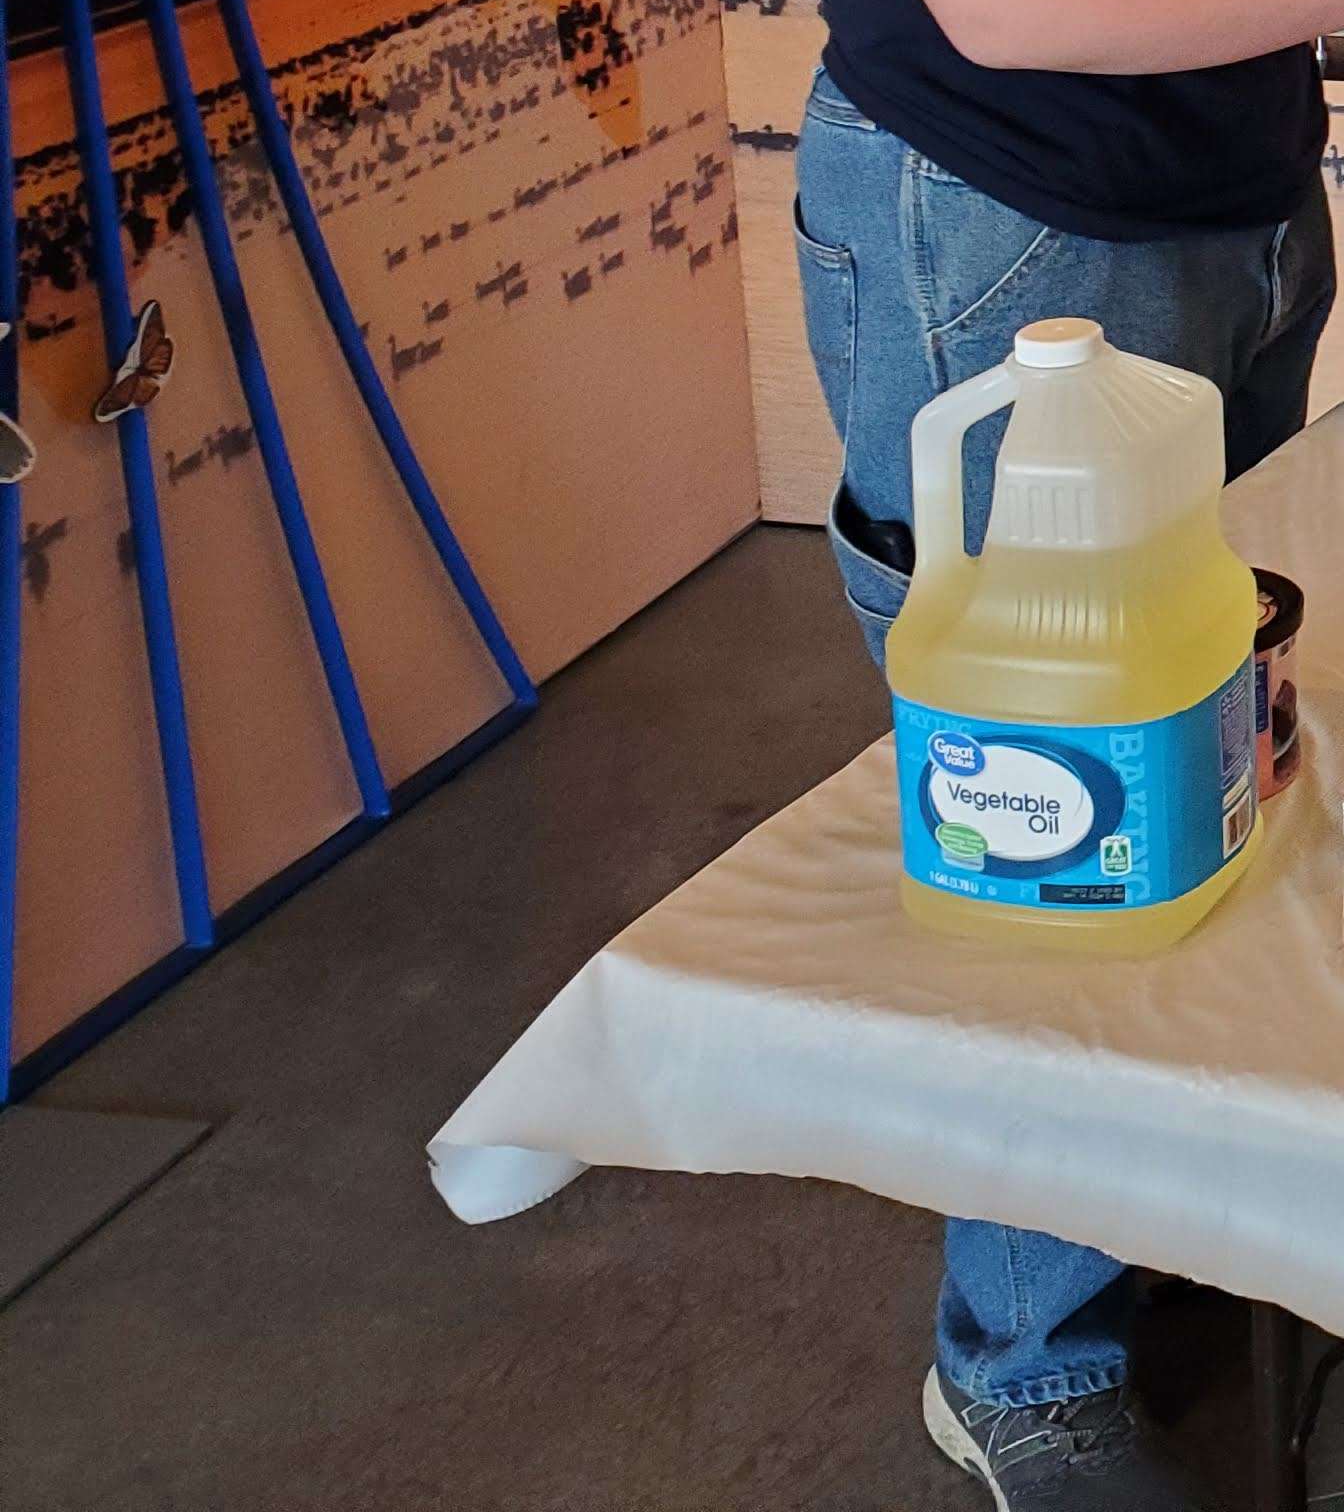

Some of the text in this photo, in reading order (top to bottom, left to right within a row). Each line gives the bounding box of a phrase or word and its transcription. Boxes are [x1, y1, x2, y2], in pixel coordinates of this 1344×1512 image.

[934, 737, 975, 761] Great
[944, 753, 976, 770] Value
[946, 780, 1061, 815] Vegetable
[1028, 815, 1060, 835] Oil
